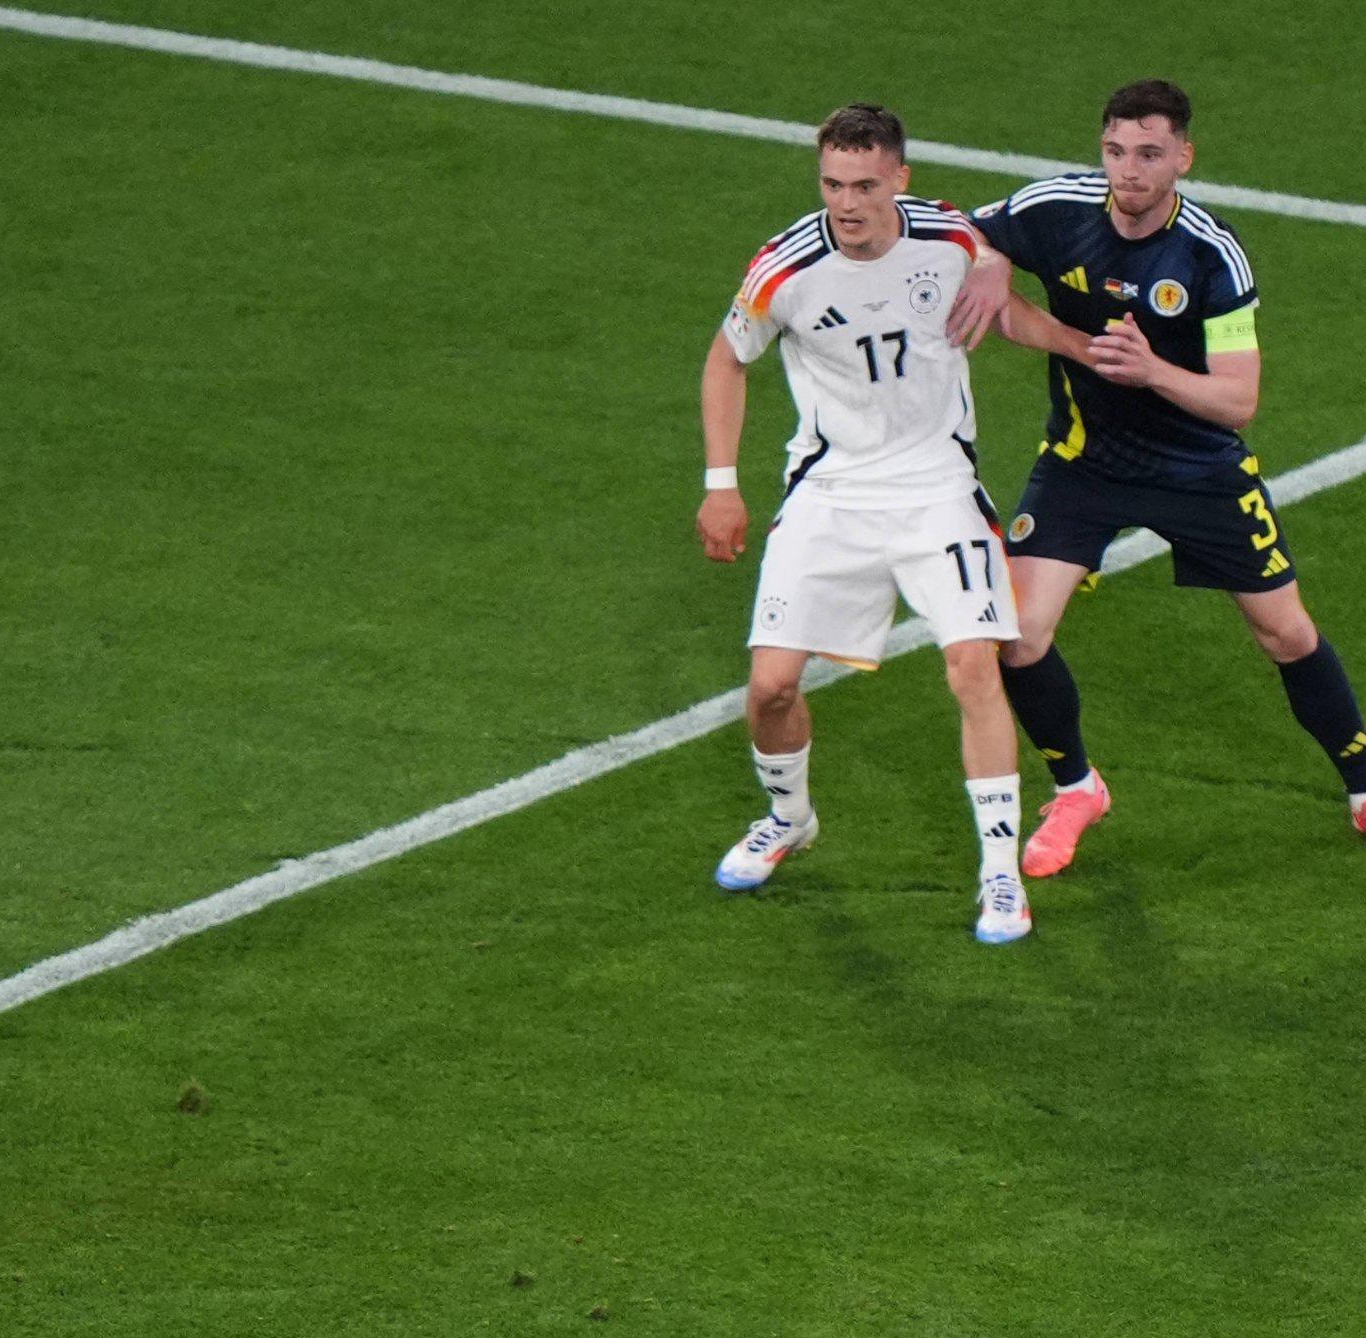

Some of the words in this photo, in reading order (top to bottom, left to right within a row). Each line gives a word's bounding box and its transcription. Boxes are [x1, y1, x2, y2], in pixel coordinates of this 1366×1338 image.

[855, 328, 909, 383] 17
[1237, 488, 1278, 551] 3
[945, 539, 993, 592] 17
[977, 792, 1013, 805] DFB
